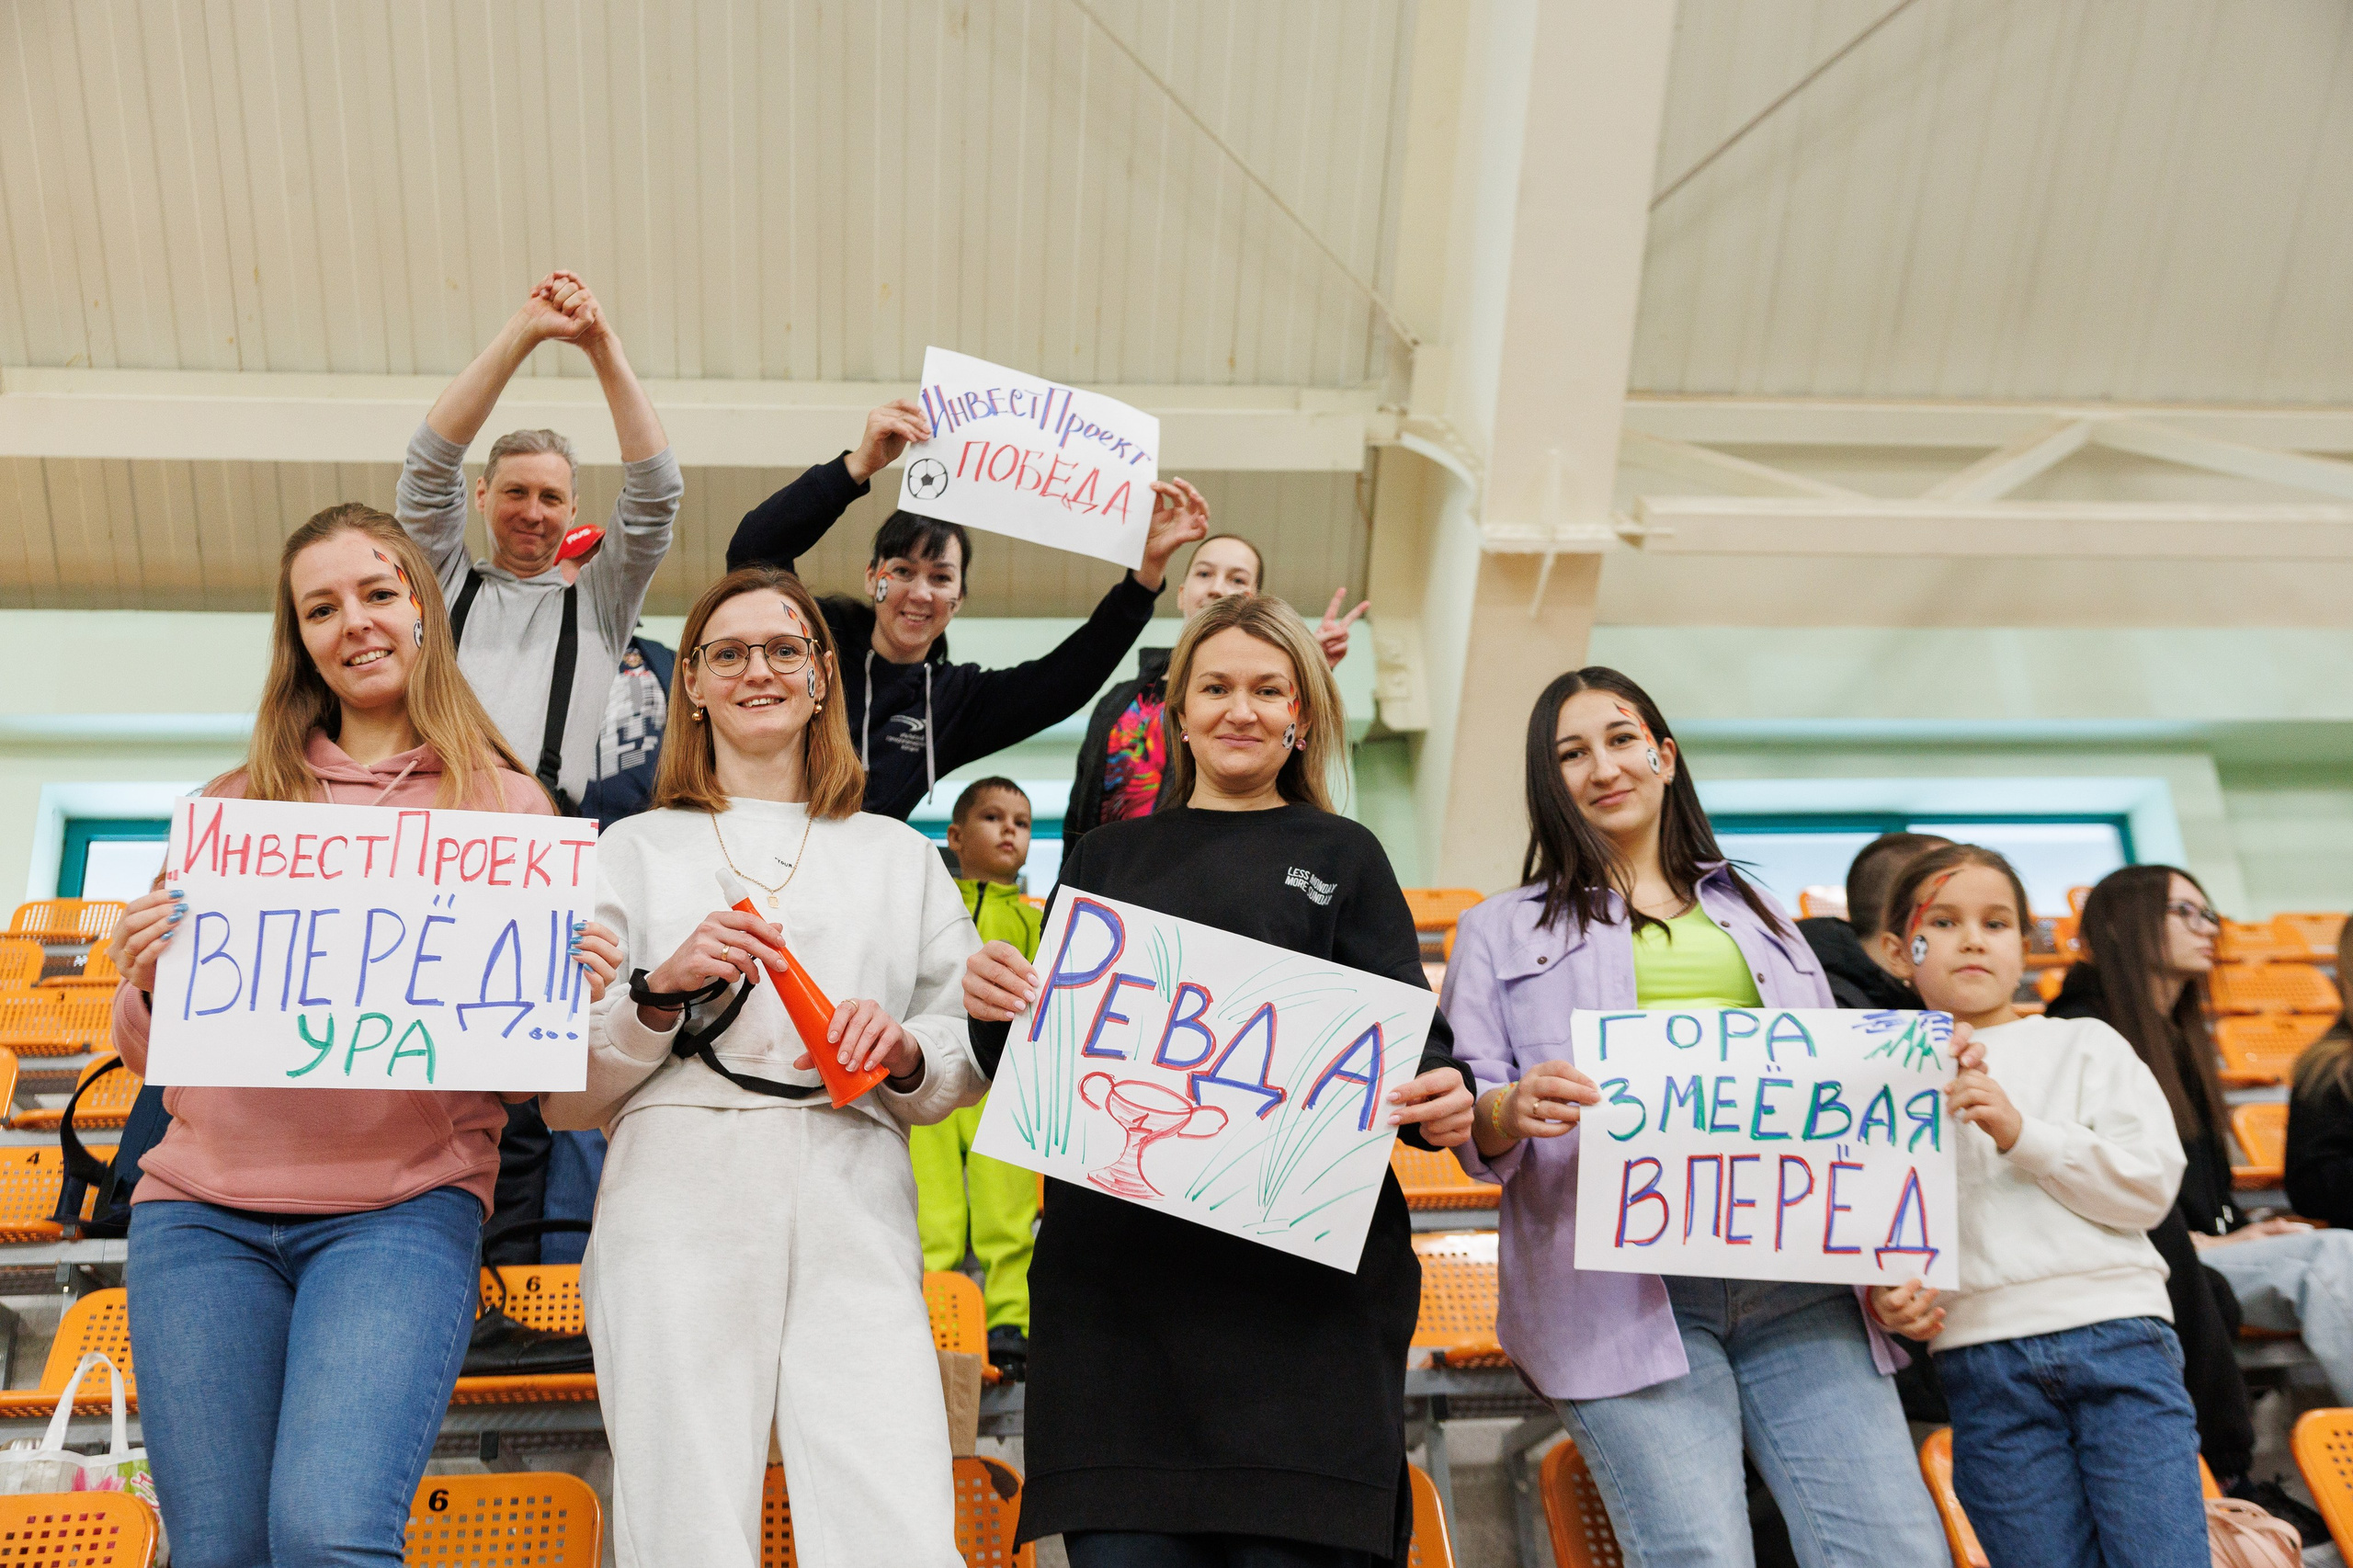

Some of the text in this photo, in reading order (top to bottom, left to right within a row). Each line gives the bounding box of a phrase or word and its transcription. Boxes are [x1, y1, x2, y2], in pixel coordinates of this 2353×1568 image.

[956, 441, 1132, 525] ПОБЕДА
[1284, 875, 1333, 906] MORE SUNDAY
[1287, 867, 1338, 895] LESS MONDAY
[1027, 897, 1385, 1132] РЕВДА
[1599, 1009, 1817, 1062] ГОРА
[286, 1013, 438, 1085] УРА
[26, 1151, 40, 1165] 4
[1614, 1143, 1939, 1276] ВПЕРЁД
[526, 1276, 540, 1292] 6
[428, 1488, 449, 1512] 6
